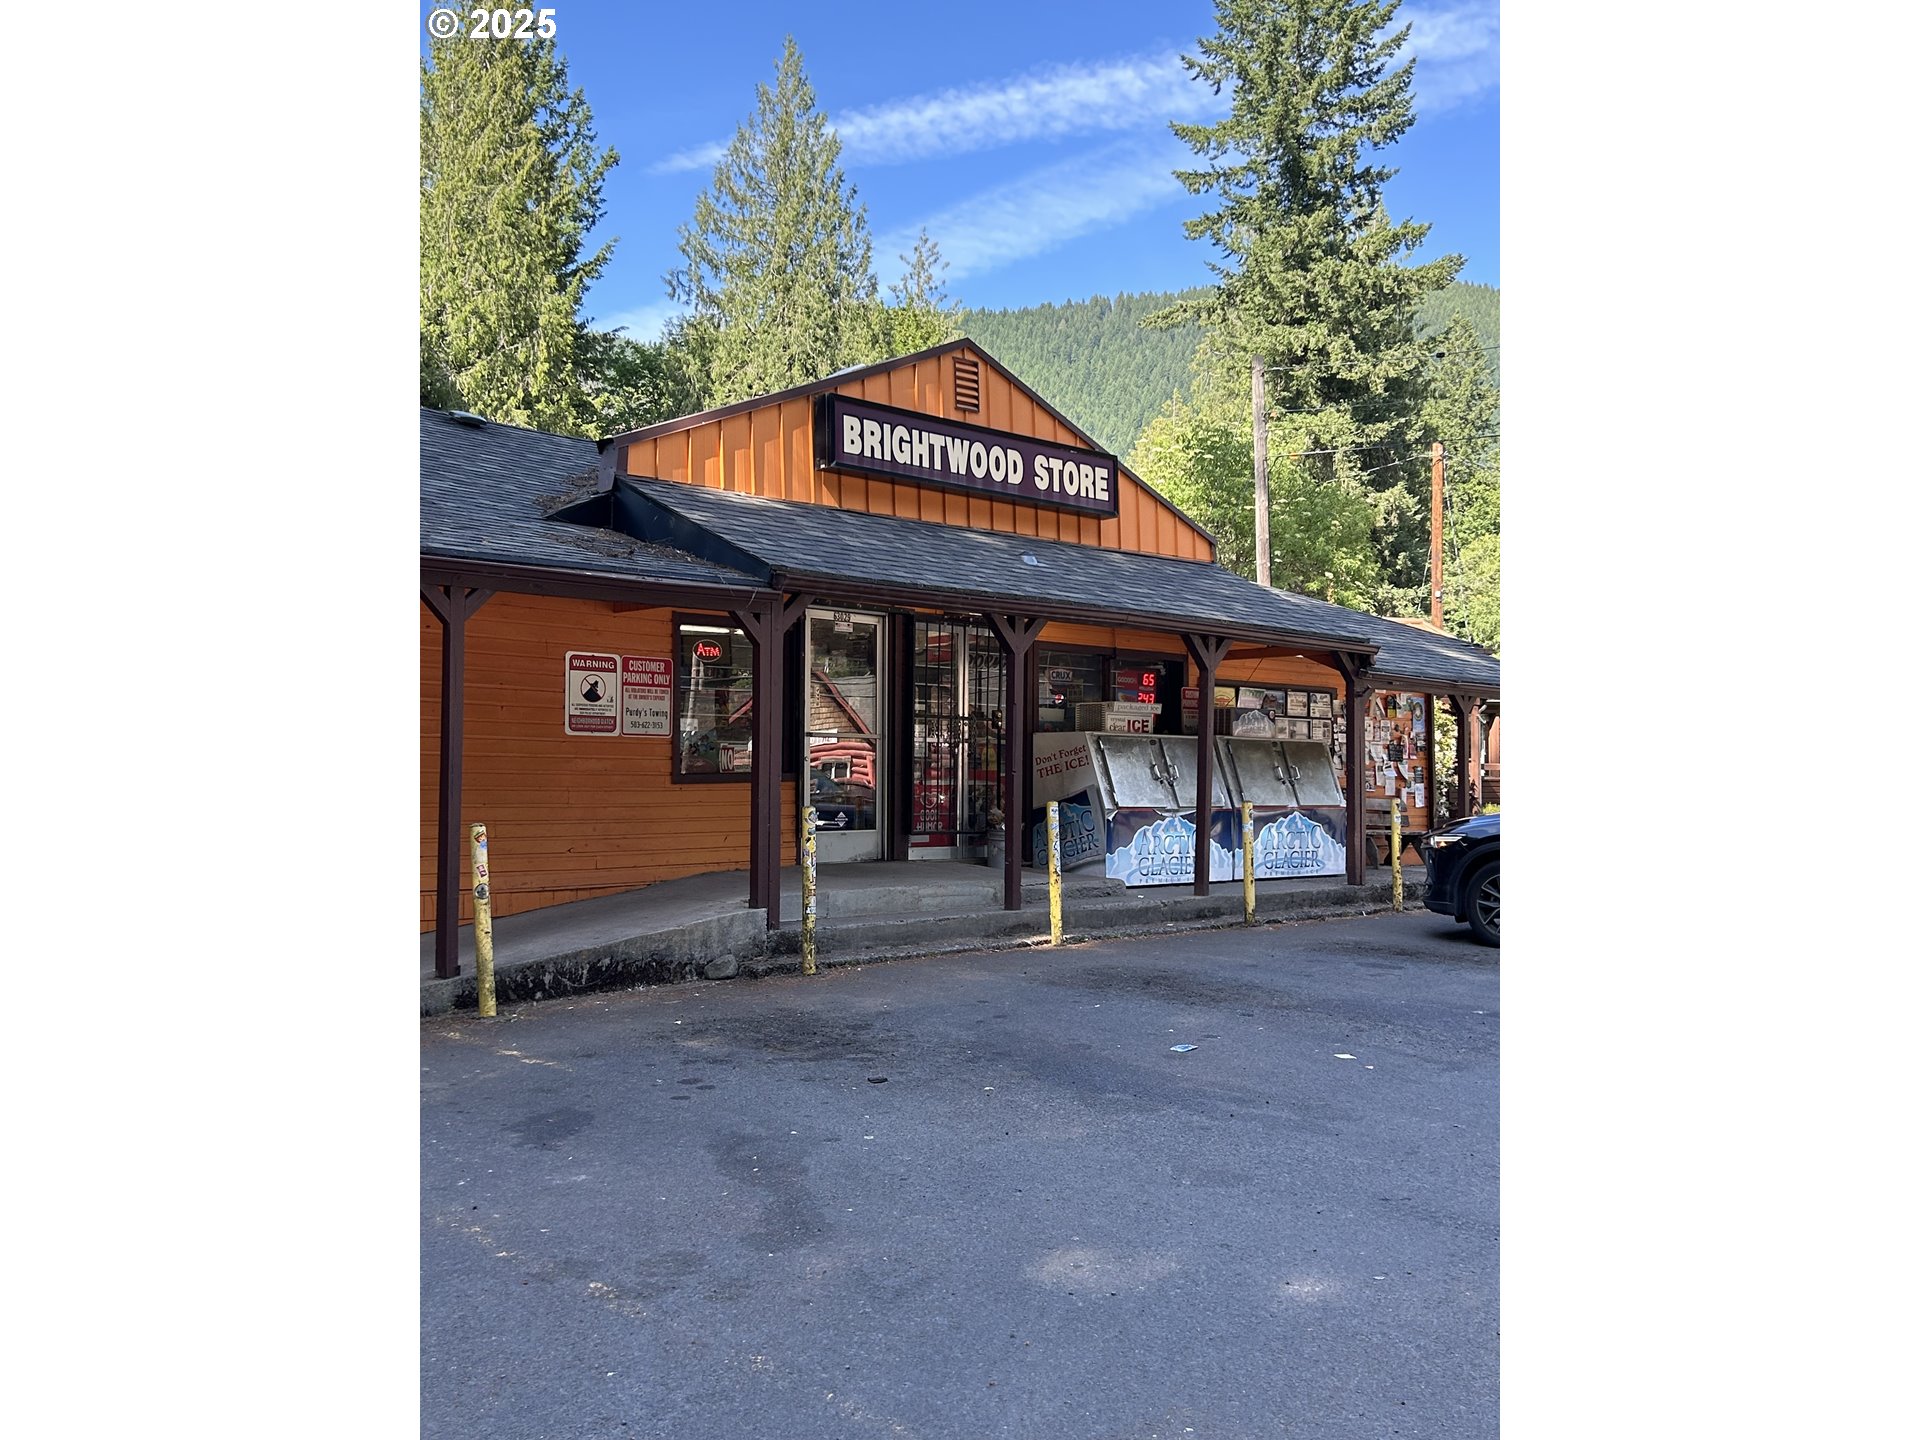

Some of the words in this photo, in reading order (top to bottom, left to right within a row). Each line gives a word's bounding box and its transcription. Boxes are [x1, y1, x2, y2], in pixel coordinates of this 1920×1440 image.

[843, 414, 1024, 485] BRIGHTWOOD
[1034, 454, 1109, 502] STORE
[572, 659, 615, 669] WARNING
[629, 660, 665, 672] CUSTOMER
[623, 672, 652, 685] PARKING
[653, 674, 670, 685] ONLY
[1051, 671, 1071, 680] CRUX
[1142, 673, 1155, 687] 65
[625, 707, 648, 718] Purdy's
[649, 708, 669, 720] Towing
[1117, 703, 1149, 712] packaged
[1127, 718, 1150, 733] ICE
[721, 748, 734, 771] NO
[1035, 751, 1057, 766] Don't
[1058, 744, 1086, 759] Forget
[1037, 763, 1062, 778] THE
[1065, 755, 1090, 770] ICE!
[1035, 810, 1095, 849] ACTIC
[1264, 825, 1321, 850] ARCTIC
[1037, 832, 1099, 866] GCIER
[1138, 856, 1195, 876] GLACIE
[1264, 851, 1320, 870] GLACIER
